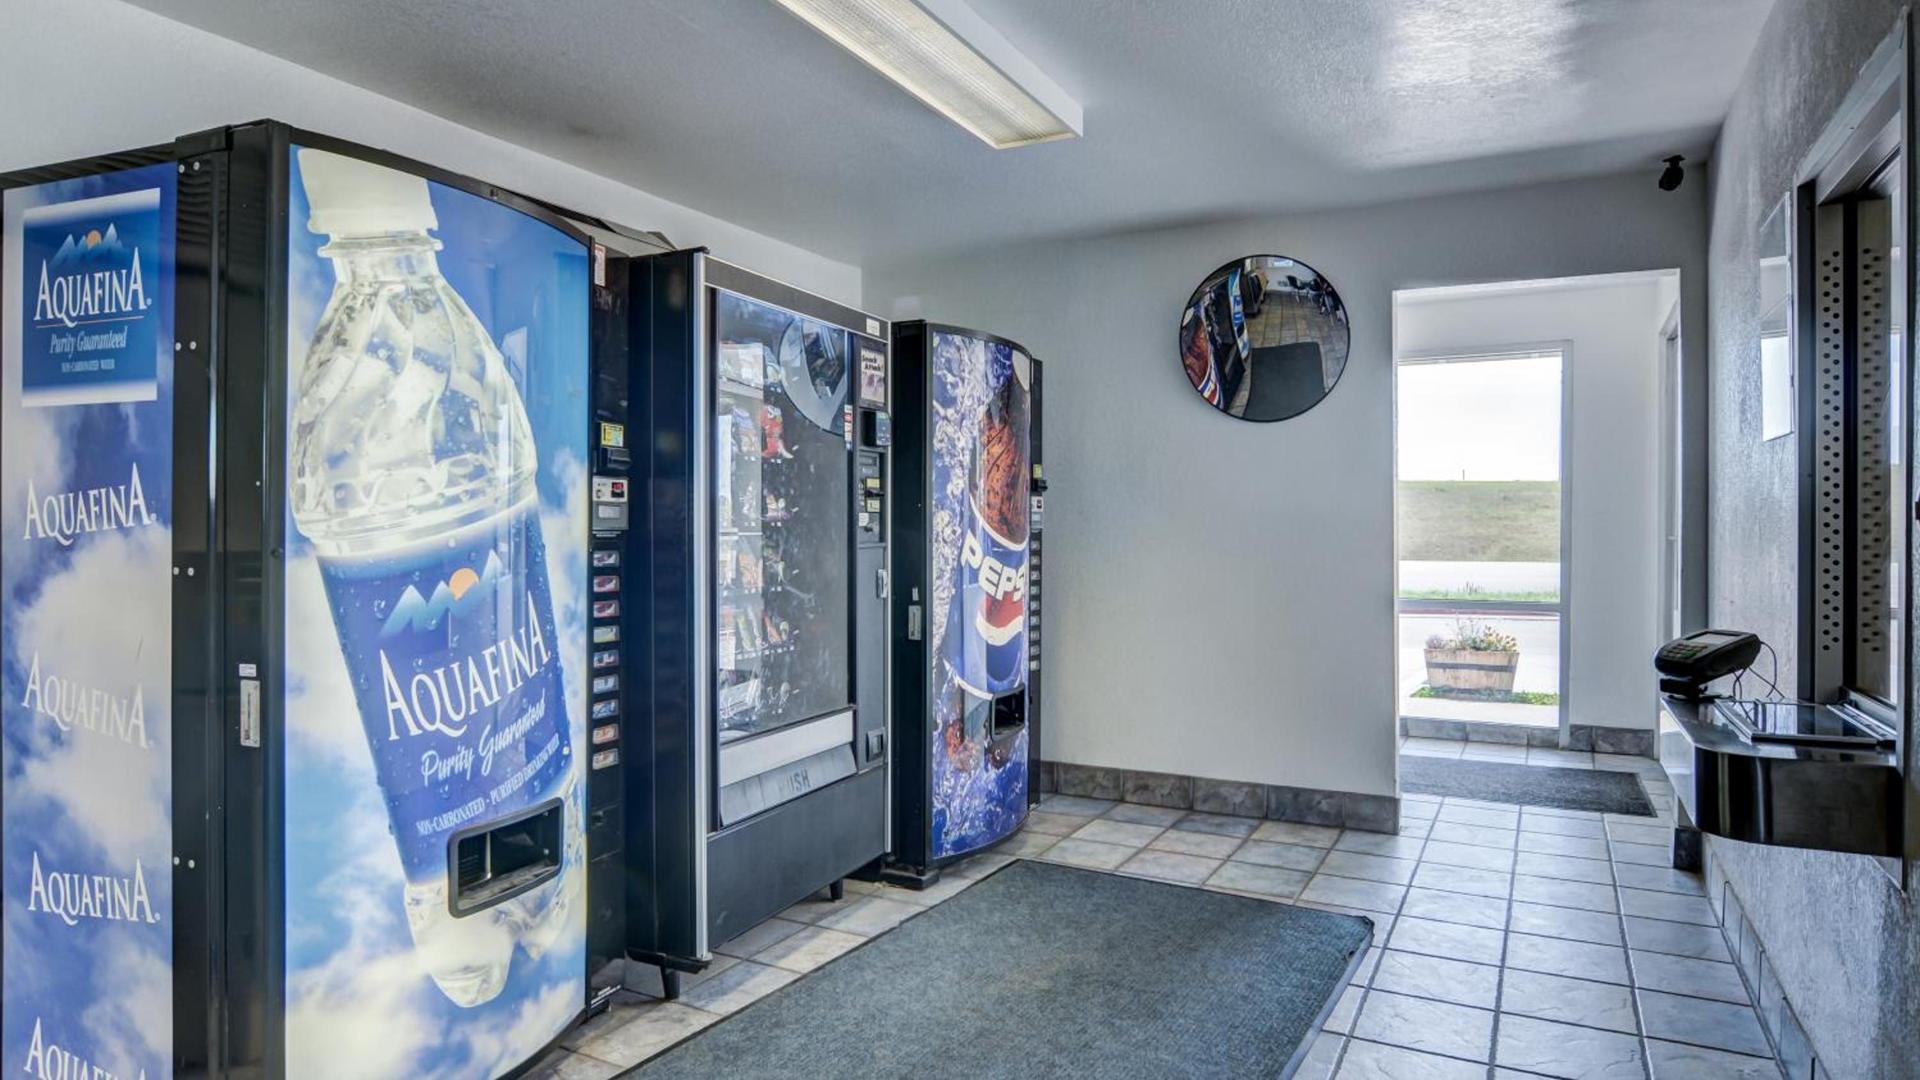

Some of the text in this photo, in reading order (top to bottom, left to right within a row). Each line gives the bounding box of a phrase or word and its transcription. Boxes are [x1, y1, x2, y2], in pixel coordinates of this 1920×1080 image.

[34, 246, 147, 328] AQUAFINA
[50, 332, 76, 359] Purity
[23, 461, 152, 546] AQUAFINA
[961, 528, 1025, 602] PEPS
[21, 650, 148, 749] AQUAFINA
[379, 589, 550, 741] AQUAFINA
[421, 688, 545, 787] Purity Guaranteed
[28, 850, 156, 926] AQUAFINA
